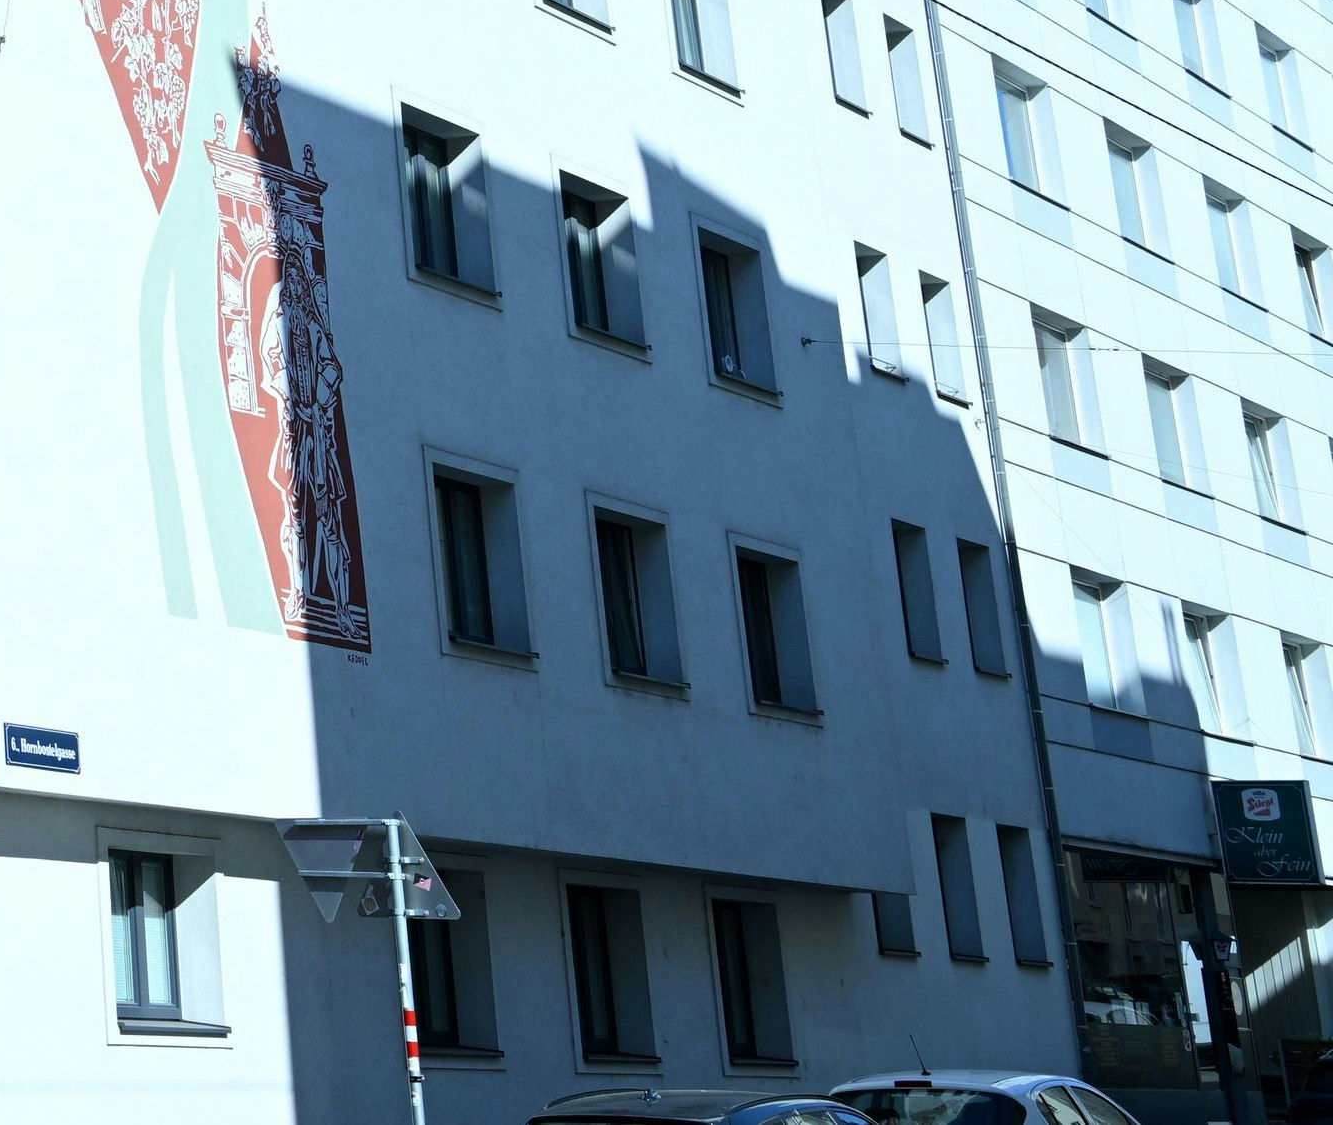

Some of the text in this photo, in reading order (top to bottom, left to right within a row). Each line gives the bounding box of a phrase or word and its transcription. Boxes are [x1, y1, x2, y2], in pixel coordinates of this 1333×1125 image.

[20, 737, 76, 761] Hornbostelgasse
[1225, 826, 1284, 844] Klein
[1257, 853, 1312, 877] Fein
